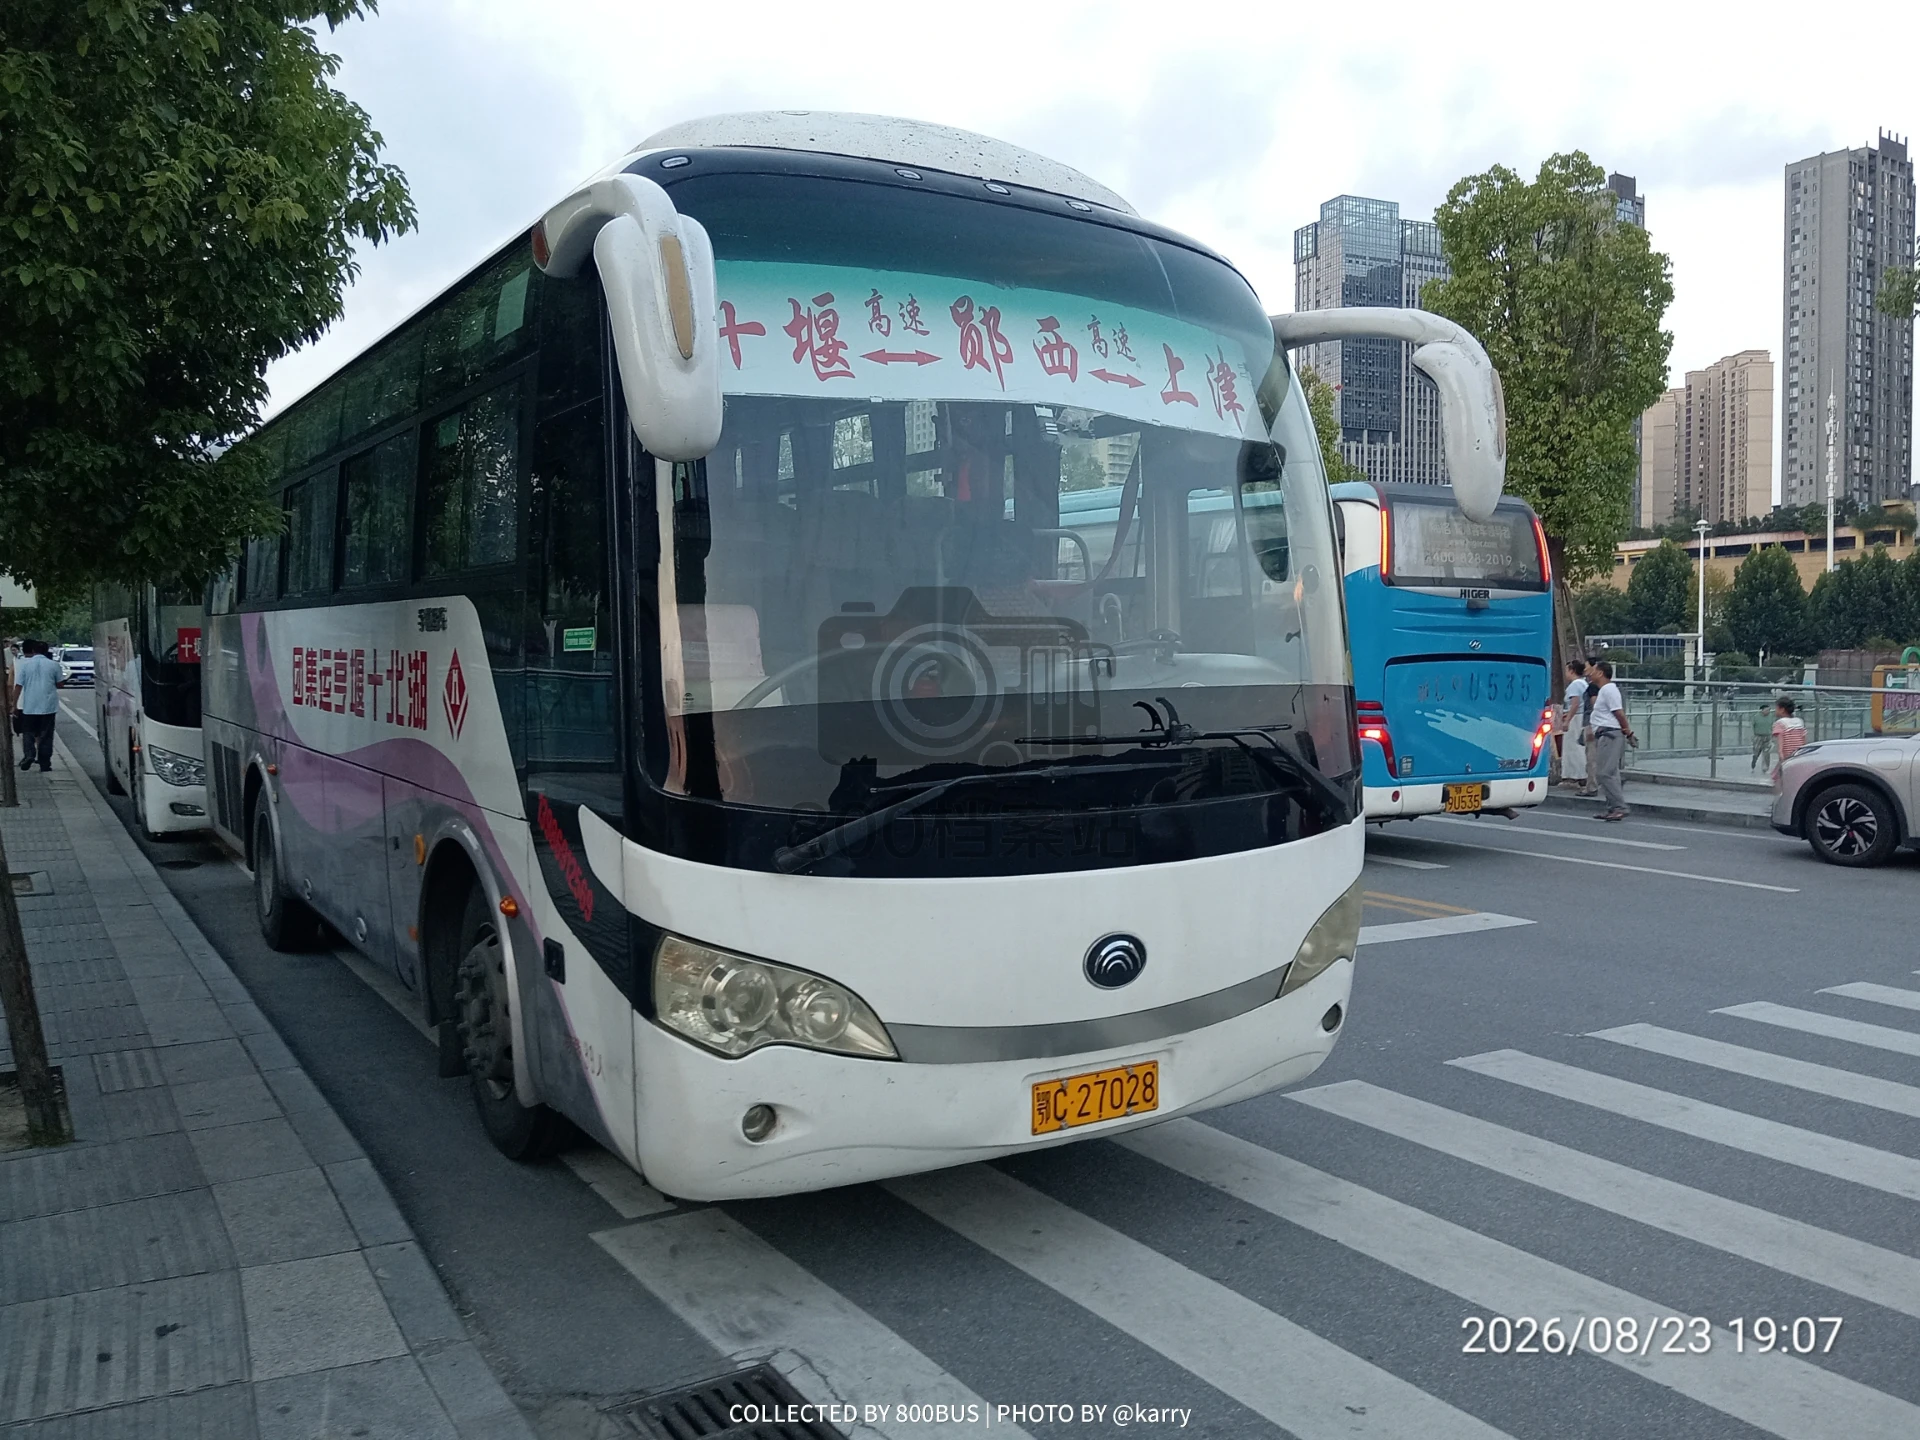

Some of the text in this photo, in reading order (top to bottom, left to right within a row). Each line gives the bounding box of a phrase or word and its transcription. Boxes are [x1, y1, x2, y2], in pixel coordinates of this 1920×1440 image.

[719, 288, 1245, 434] 十堰 高速 郧西 高速 上津
[1460, 589, 1490, 599] HIGER
[1448, 794, 1480, 811] 9U535
